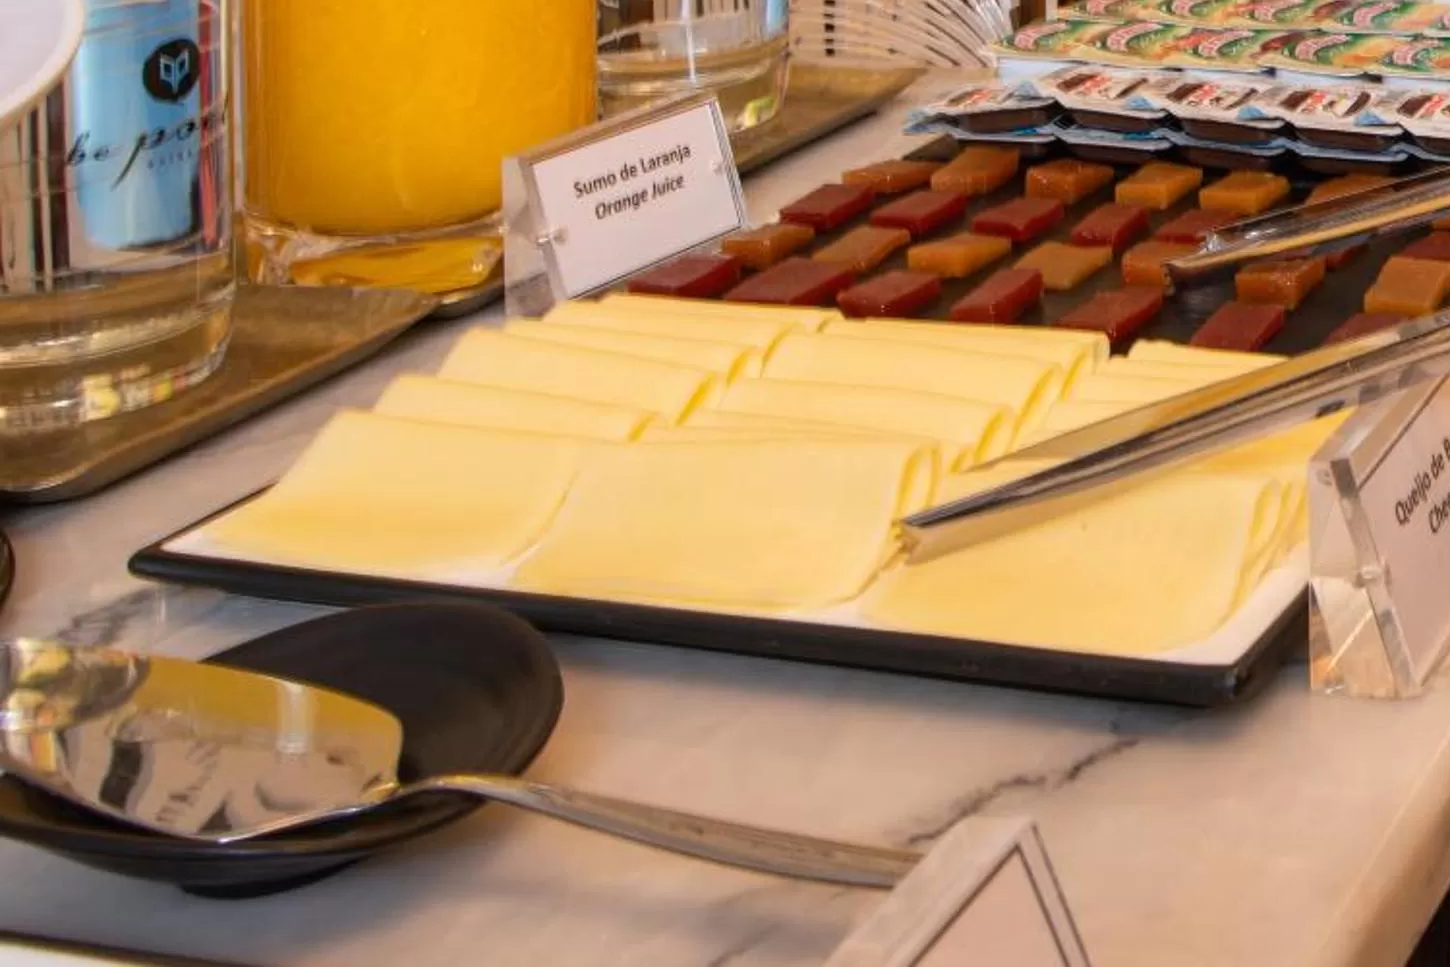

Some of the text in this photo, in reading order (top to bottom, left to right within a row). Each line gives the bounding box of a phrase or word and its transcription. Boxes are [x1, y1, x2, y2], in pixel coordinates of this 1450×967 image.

[573, 145, 691, 199] Sumo de Laranja
[595, 175, 684, 220] Orange Juice
[1395, 472, 1432, 525] Queijo
[1430, 453, 1445, 480] de
